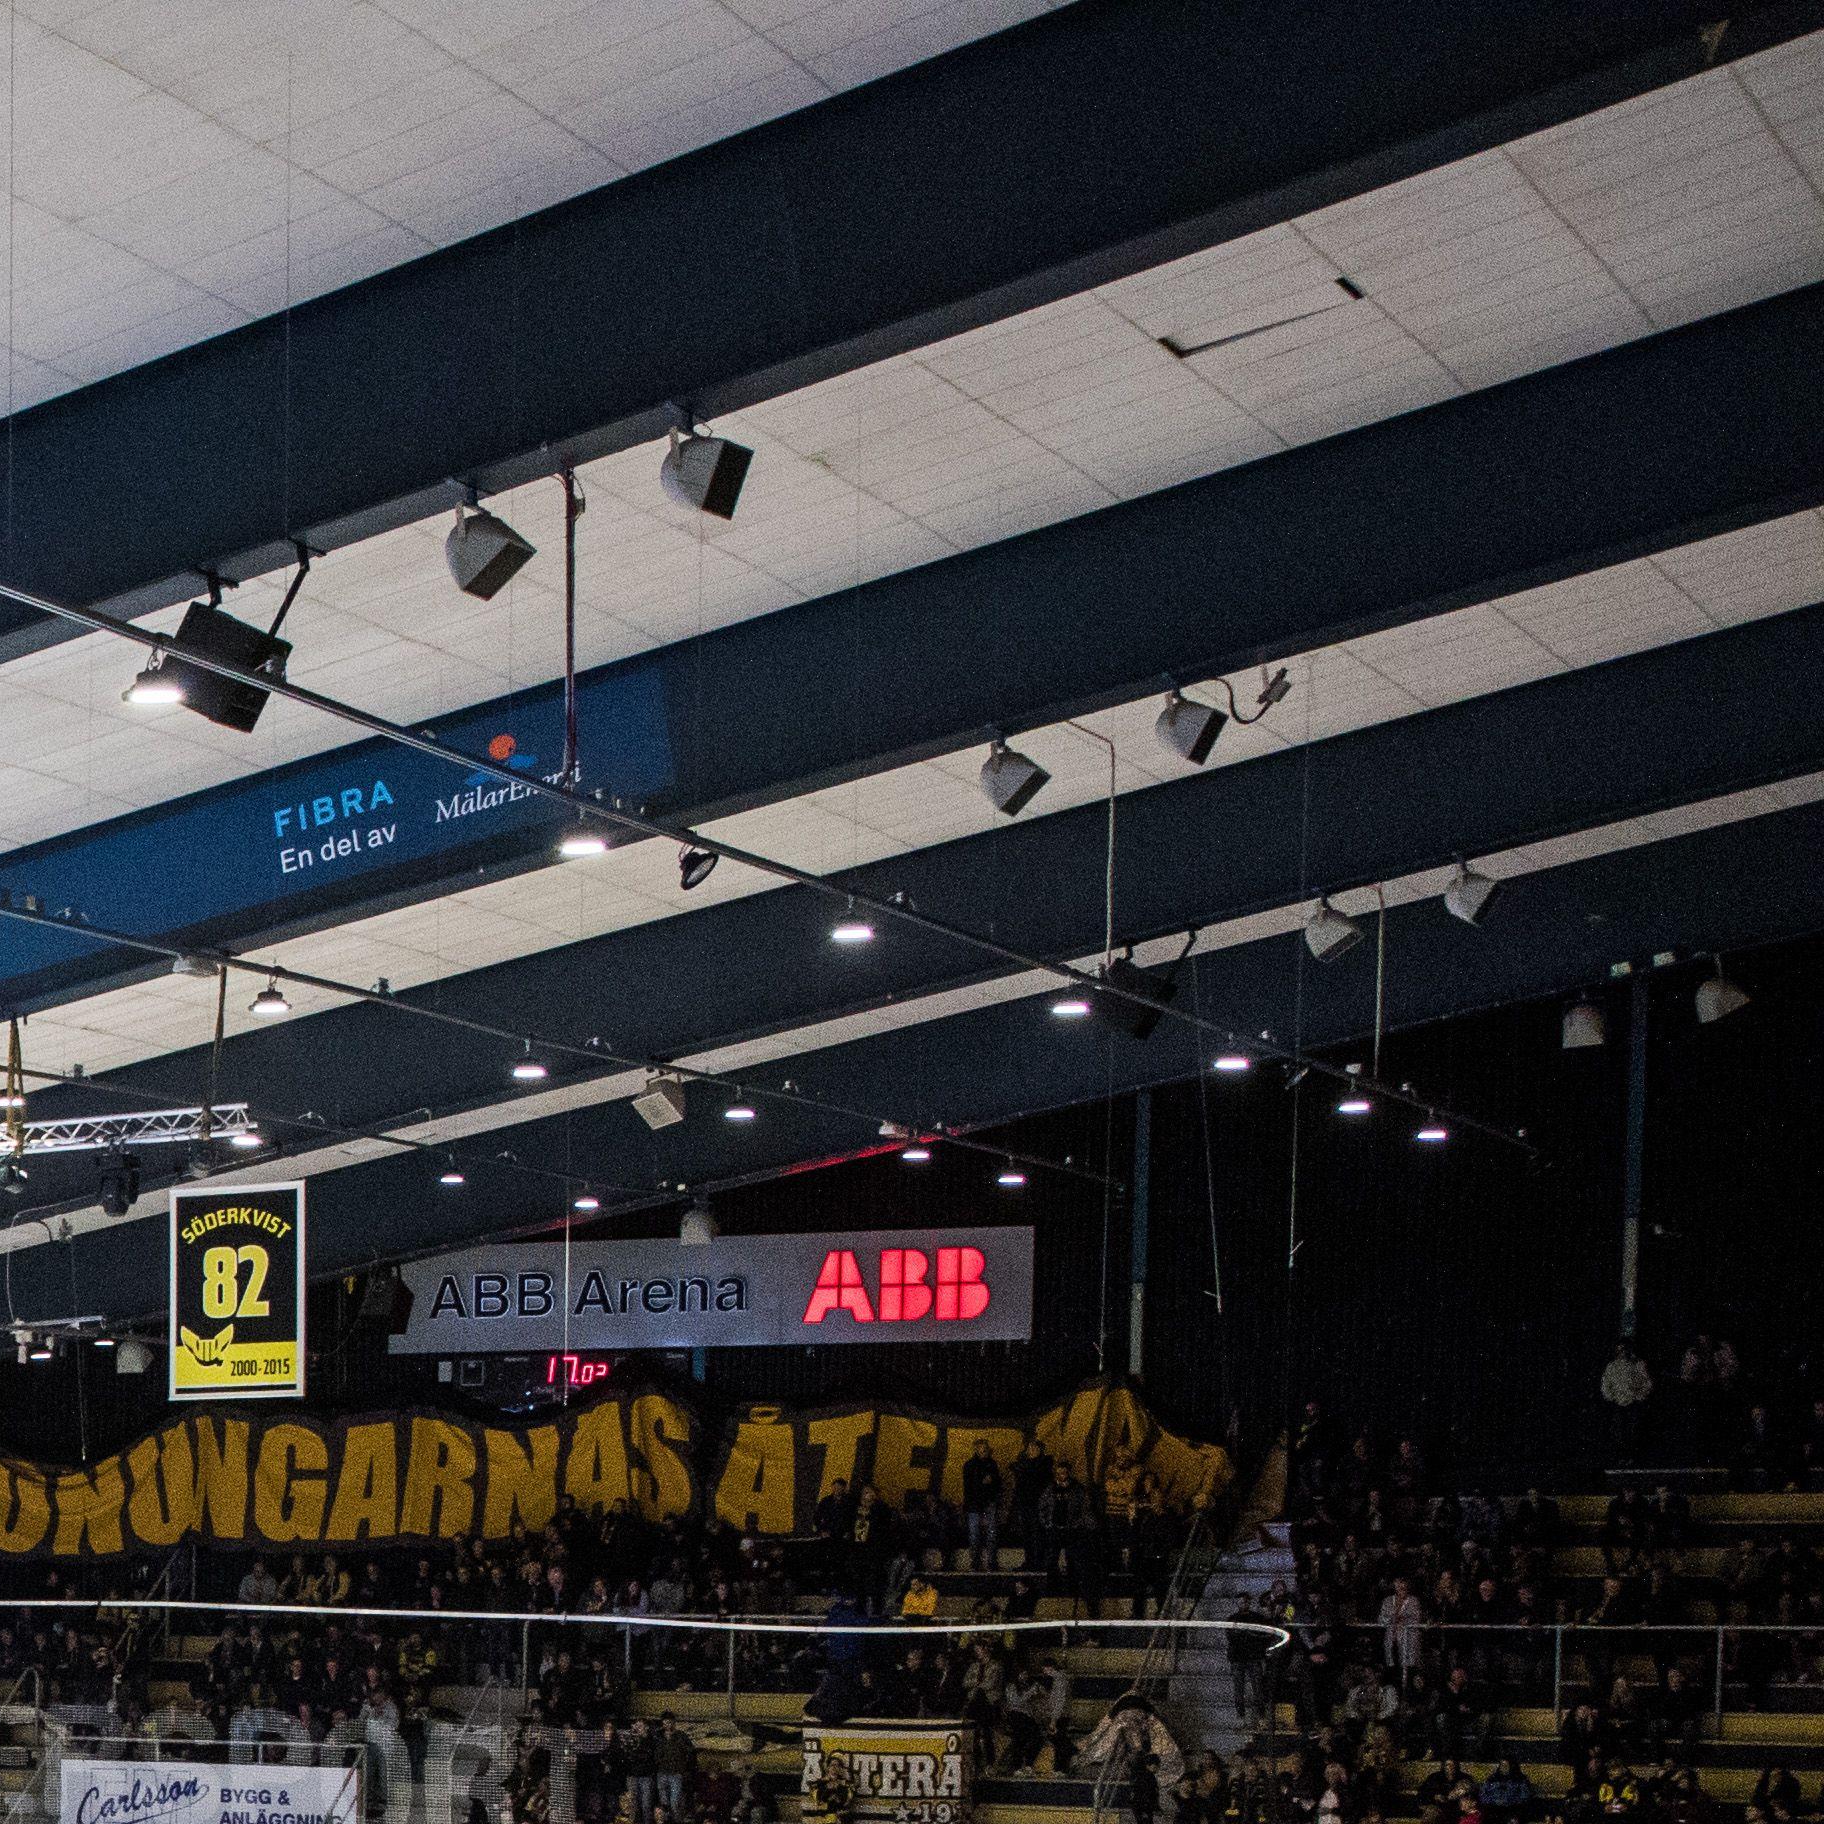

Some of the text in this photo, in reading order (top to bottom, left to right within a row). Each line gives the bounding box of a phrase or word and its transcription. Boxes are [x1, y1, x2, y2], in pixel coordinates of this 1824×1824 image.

[275, 782, 393, 838] FIBRA
[280, 825, 396, 873] En del av
[181, 1207, 291, 1245] SÖDERKVIST
[203, 1245, 270, 1318] 82
[428, 1268, 748, 1321] ABB Arena
[803, 1246, 992, 1324] ABB
[230, 1358, 291, 1377] 2000-2015
[220, 1788, 290, 1807] BYGG &
